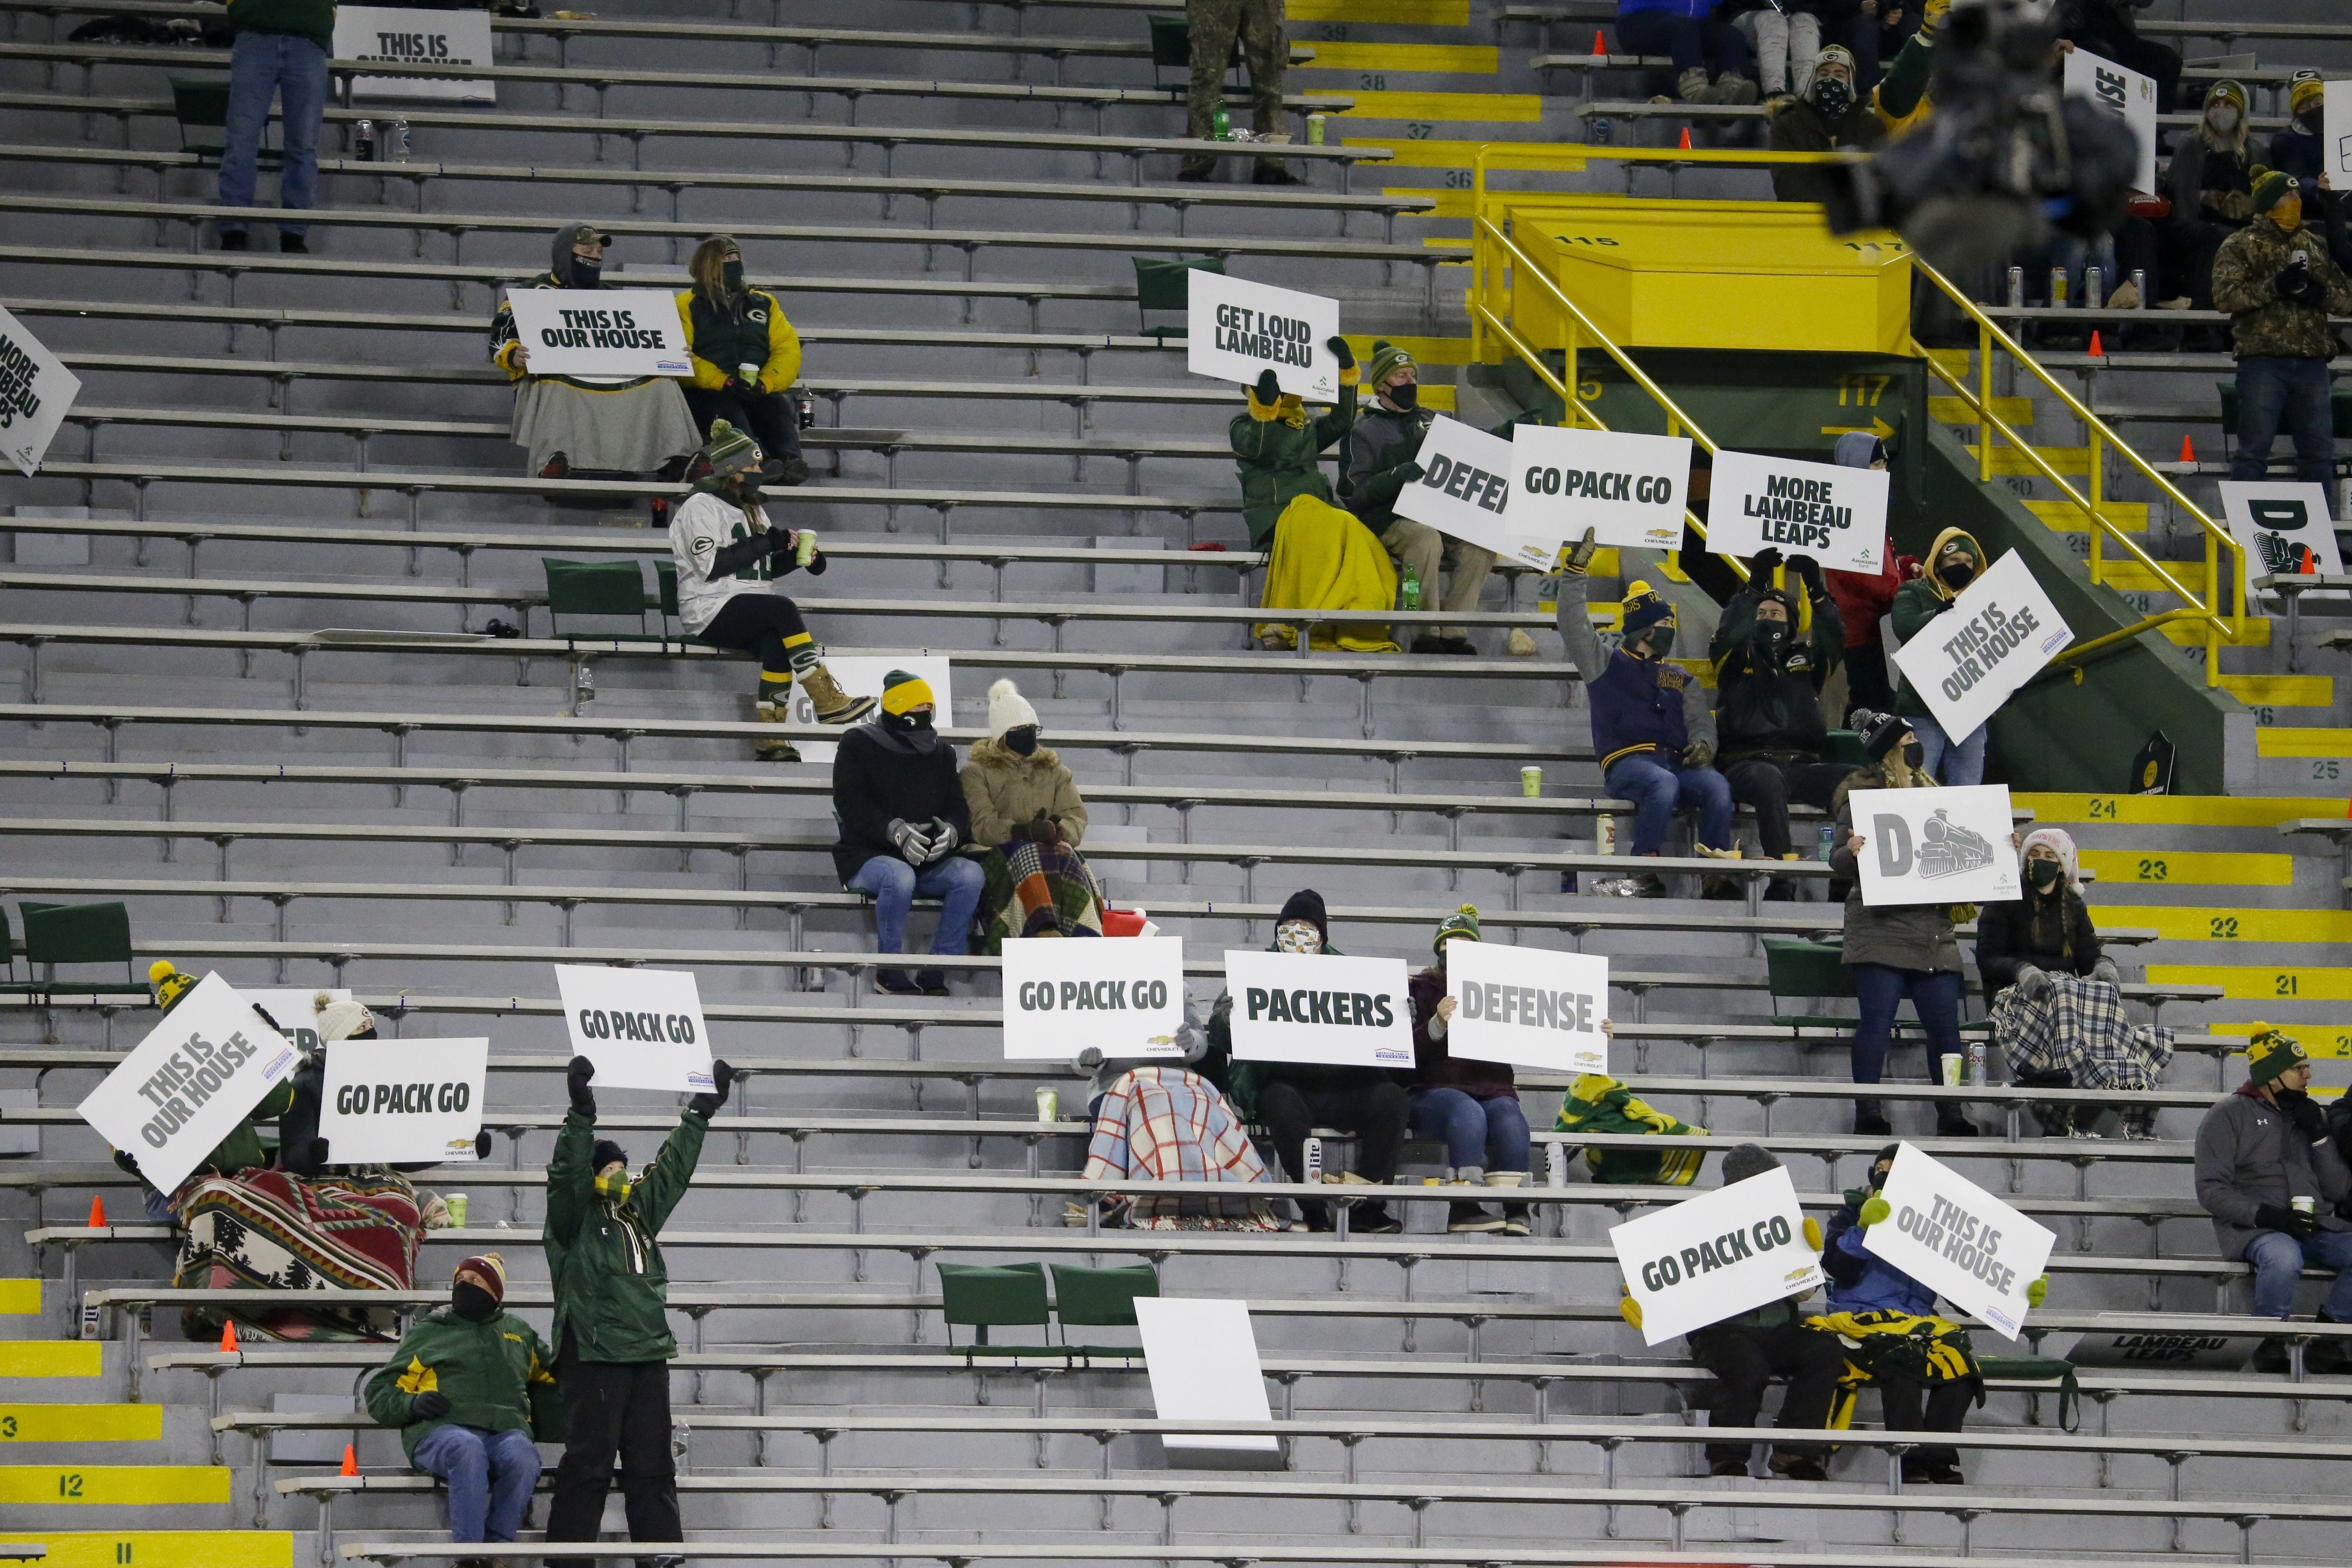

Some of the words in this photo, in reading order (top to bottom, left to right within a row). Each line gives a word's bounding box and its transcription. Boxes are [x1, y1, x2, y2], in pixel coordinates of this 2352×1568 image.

[1322, 24, 1347, 41] 39
[377, 33, 425, 56] THIS
[428, 35, 447, 57] IS
[1360, 74, 1386, 91] 38
[1407, 124, 1433, 140] 37
[1445, 171, 1472, 188] 36
[1554, 236, 1619, 245] 115
[1844, 243, 1902, 251] 117
[559, 310, 611, 328] THIS
[612, 311, 635, 329] IS
[1217, 304, 1253, 332] GET
[1259, 312, 1311, 344] LOUD
[542, 328, 590, 348] OUR
[591, 329, 666, 349] HOUSE
[1216, 326, 1311, 368] LAMBEAU
[1312, 385, 1334, 393] Associated
[1839, 375, 1890, 406] 117
[1525, 466, 1560, 495] GO
[1565, 470, 1632, 501] PACK
[1636, 476, 1671, 504] GO
[1767, 475, 1832, 504] MORE
[1744, 495, 1852, 529] LAMBEAU
[2248, 500, 2308, 530] D
[1762, 519, 1830, 549] LEAPS
[1519, 553, 1548, 566] CHEVROLET
[1943, 618, 1988, 665] THIS
[1981, 602, 2006, 632] IS
[1942, 658, 1985, 701] OUR
[1976, 606, 2039, 670] HOUSE
[2313, 761, 2338, 779] 25
[2090, 799, 2116, 818] 24
[1873, 814, 1913, 877] D
[2030, 834, 2060, 848] PACKERS
[2139, 860, 2166, 880] 23
[2211, 917, 2238, 937] 22
[1019, 981, 1054, 1010] GO
[1061, 981, 1127, 1009] PACK
[1132, 980, 1166, 1009] GO
[2276, 975, 2297, 995] 21
[1247, 988, 1393, 1027] PACKERS
[1463, 981, 1593, 1033] DEFENSE
[580, 1009, 609, 1039] GO
[610, 1011, 666, 1042] PACK
[666, 1014, 695, 1044] GO
[2337, 1036, 2352, 1055] 2
[138, 1053, 194, 1107] THIS
[182, 1032, 214, 1065] IS
[142, 1098, 195, 1148] OUR
[181, 1031, 257, 1108] HOUSE
[337, 1085, 369, 1115] GO
[374, 1084, 434, 1113] PACK
[438, 1083, 469, 1112] GO
[1309, 1145, 1321, 1168] Lite
[1931, 1194, 1979, 1241] THIS
[1977, 1225, 2002, 1255] IS
[1642, 1256, 1680, 1291] GO
[1681, 1229, 1753, 1279] PACK
[1753, 1216, 1791, 1251] GO
[1897, 1206, 1944, 1252] OUR
[1943, 1234, 2015, 1295] HOUSE
[1786, 1275, 1818, 1289] CHEVROLET
[84, 1305, 99, 1322] Lit
[2112, 1334, 2228, 1351] LAMBEAU
[2124, 1348, 2195, 1362] LEAPS
[60, 1475, 82, 1496] 12
[118, 1543, 131, 1564] 11
